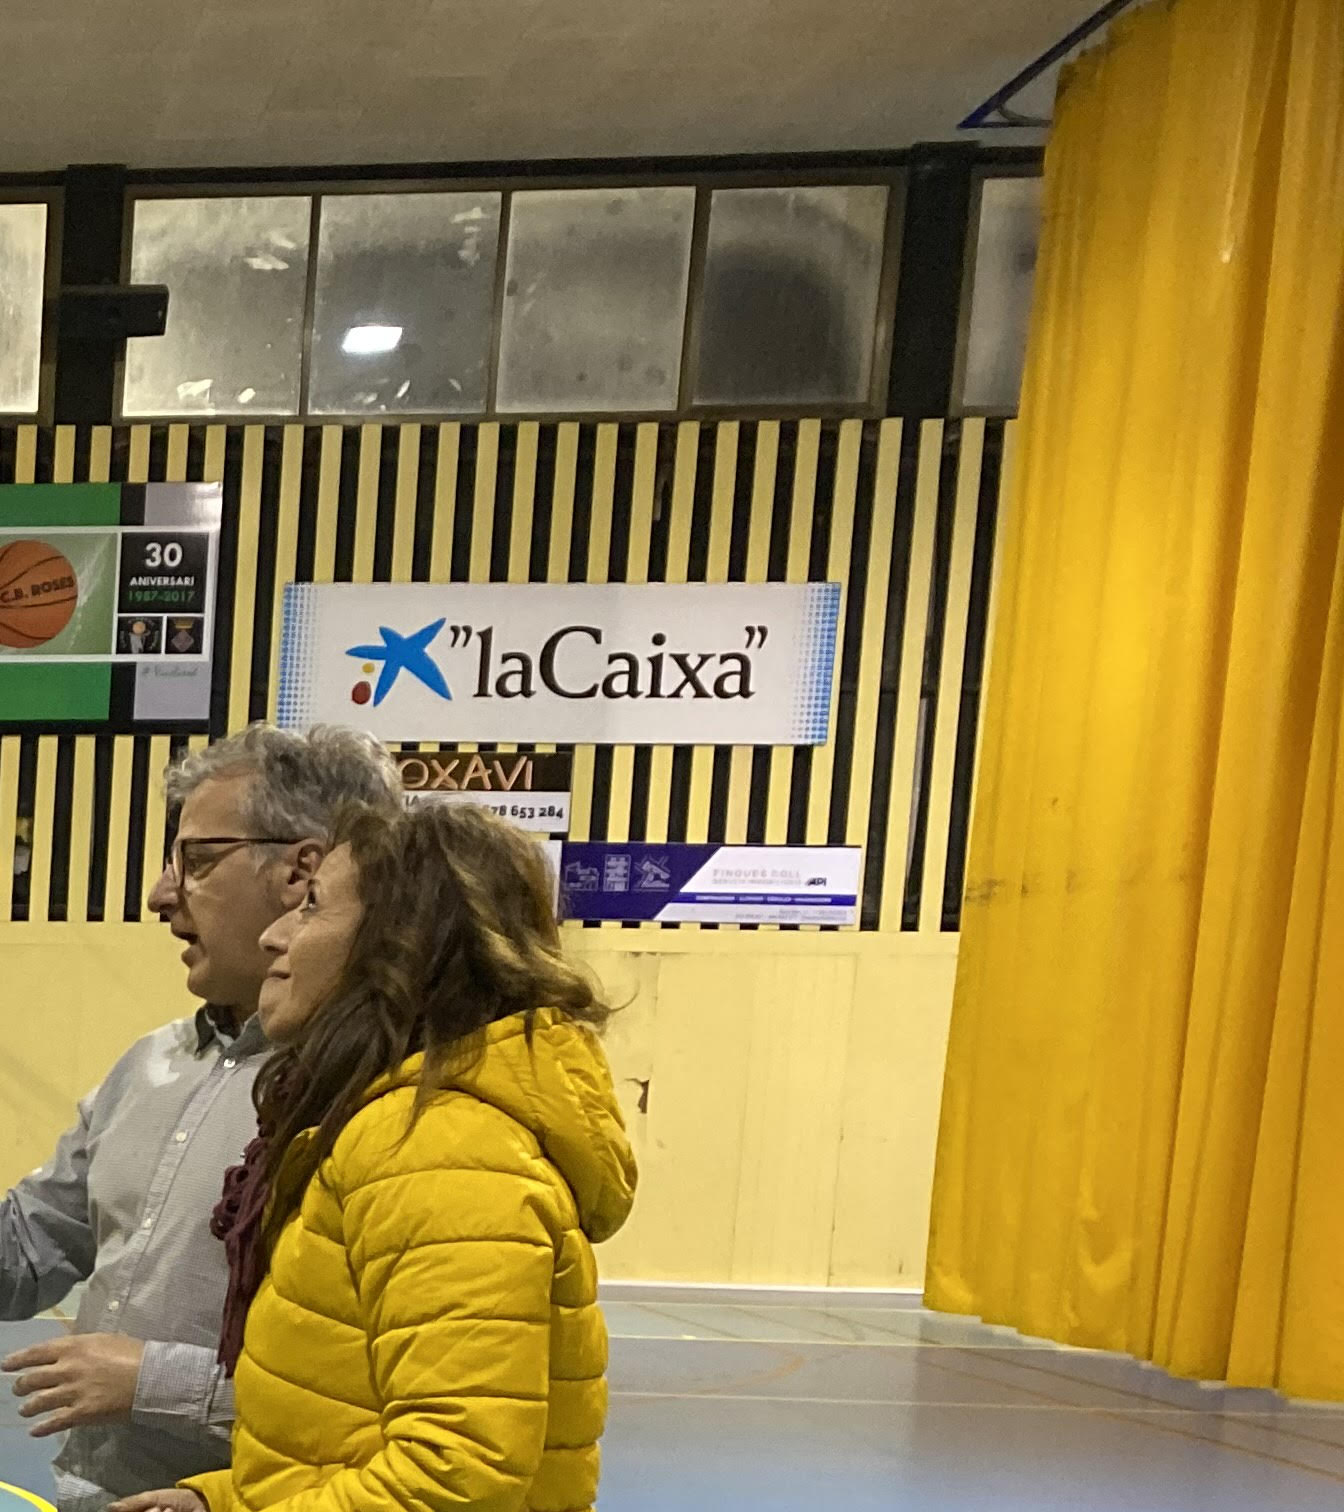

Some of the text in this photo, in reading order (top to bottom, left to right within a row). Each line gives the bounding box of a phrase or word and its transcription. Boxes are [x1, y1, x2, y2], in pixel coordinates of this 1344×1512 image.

[144, 542, 183, 567] 30
[128, 576, 195, 587] ANIVERSARI
[511, 805, 535, 819] 653
[539, 806, 564, 819] 284
